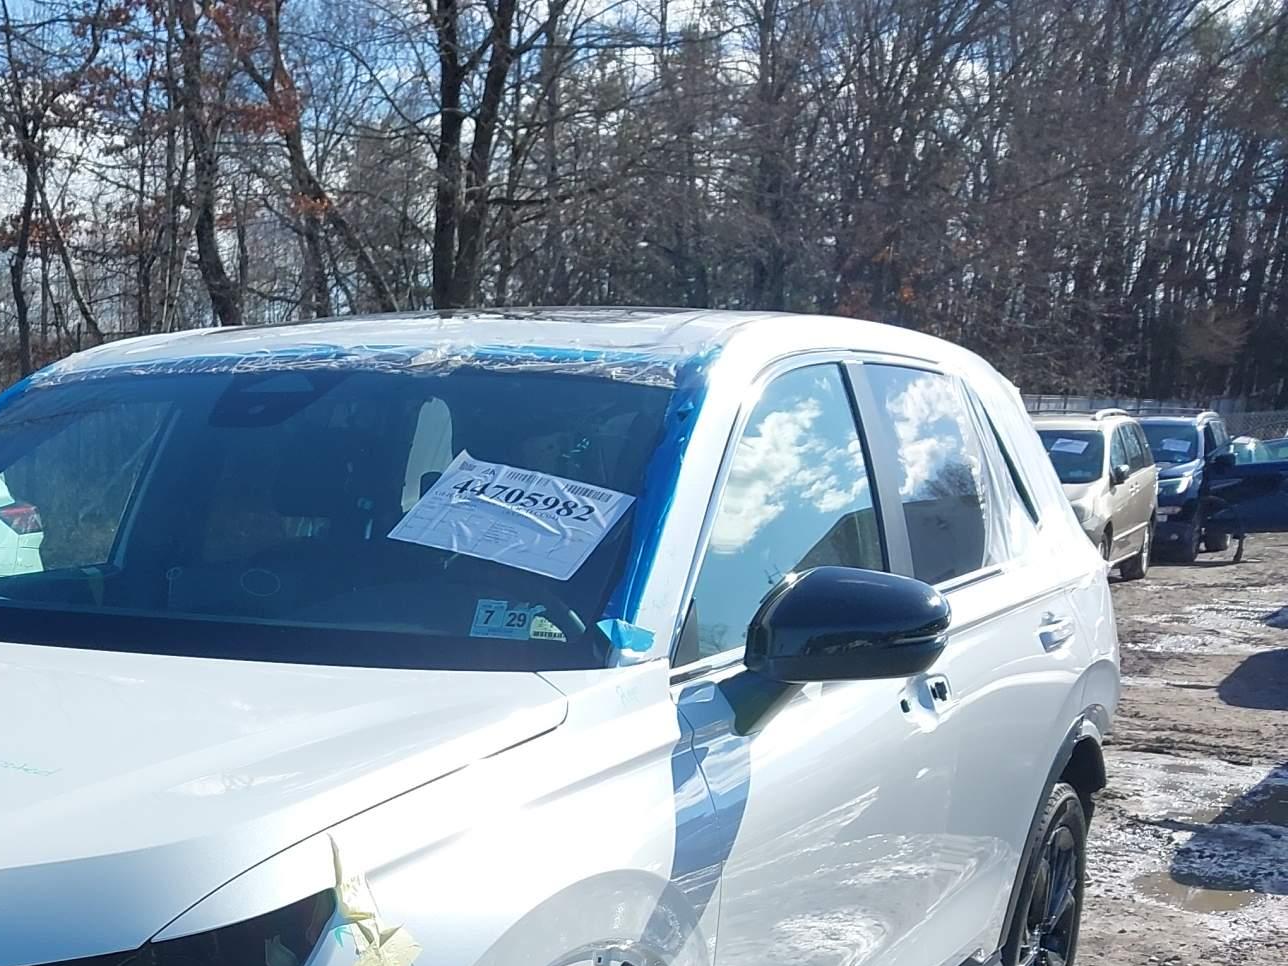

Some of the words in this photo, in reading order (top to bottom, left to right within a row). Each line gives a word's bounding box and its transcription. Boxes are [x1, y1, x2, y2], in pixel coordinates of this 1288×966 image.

[452, 479, 596, 522] 44705982
[483, 610, 495, 625] 7
[505, 612, 527, 628] 29
